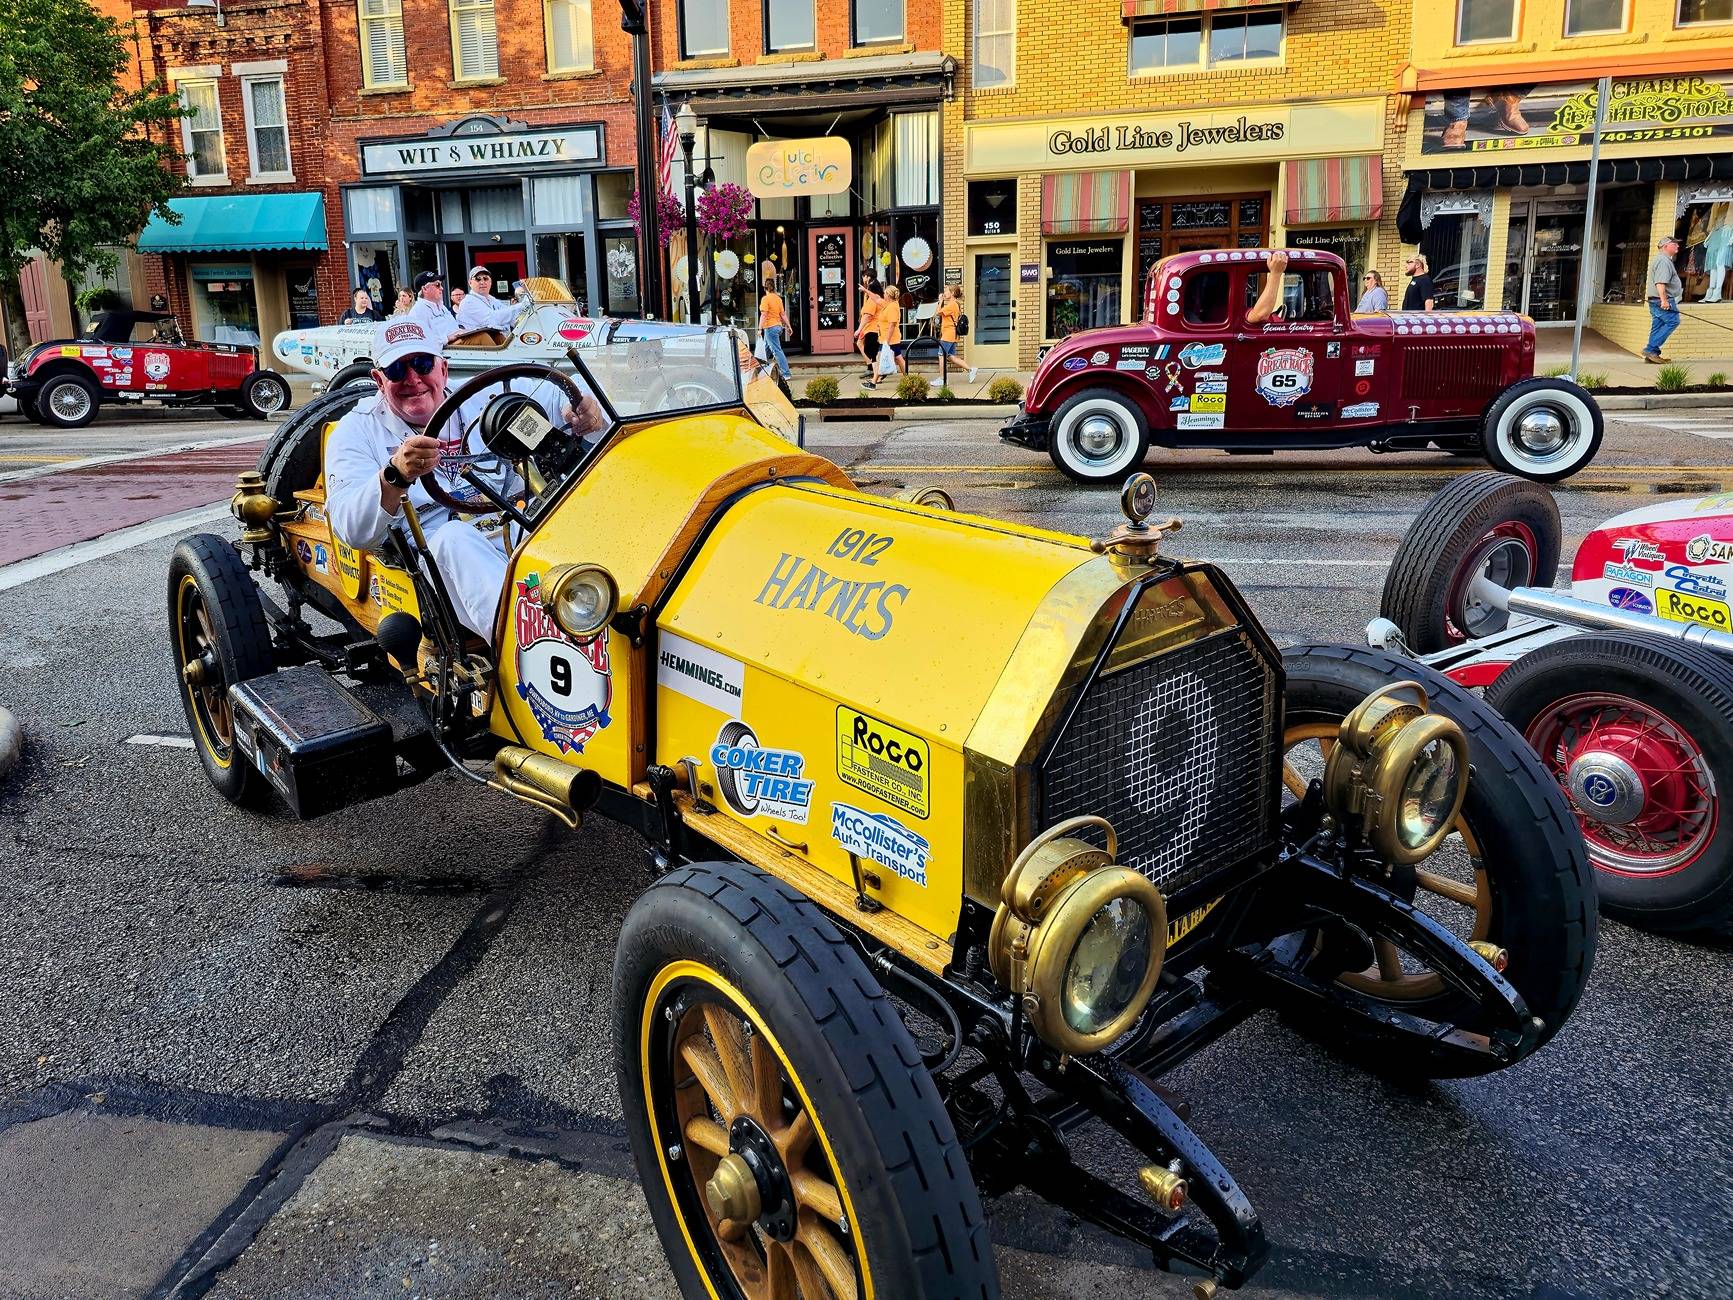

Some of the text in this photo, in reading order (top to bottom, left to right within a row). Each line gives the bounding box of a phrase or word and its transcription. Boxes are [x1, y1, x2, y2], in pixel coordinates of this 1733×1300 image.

[1549, 104, 1660, 131] LEAHER
[1049, 116, 1284, 154] Gold Line Jewelers
[1600, 126, 1713, 141] 740-373-5101
[398, 147, 440, 164] WIT
[468, 138, 566, 160] WHIMZY
[1088, 245, 1114, 254] Jewelers
[1331, 235, 1360, 244] Jewelers
[562, 322, 593, 331] THERMON
[1261, 358, 1311, 374] GREAT RACE
[1272, 375, 1297, 387] 65
[1180, 415, 1221, 425] Hemmings
[826, 528, 895, 566] 1912
[1638, 551, 1665, 560] Vintiques
[1606, 567, 1651, 582] PARAGON
[1665, 566, 1724, 585] Corvette
[1675, 578, 1727, 597] Central
[754, 552, 912, 641] HAYNES
[1669, 593, 1726, 625] ROGO
[516, 598, 562, 646] GREA
[550, 655, 572, 697] 9
[660, 651, 741, 698] HEMMINGS.COM
[853, 715, 924, 772] ROGO
[712, 744, 804, 778] COKER
[744, 772, 812, 806] TIRE
[842, 772, 925, 817] www.ROGOFASTENER.com
[853, 764, 890, 789] FASTENER
[908, 788, 924, 803] INC.
[760, 803, 806, 822] Wheels Too!
[833, 806, 926, 868] McCollister's
[864, 840, 927, 887] Transport
